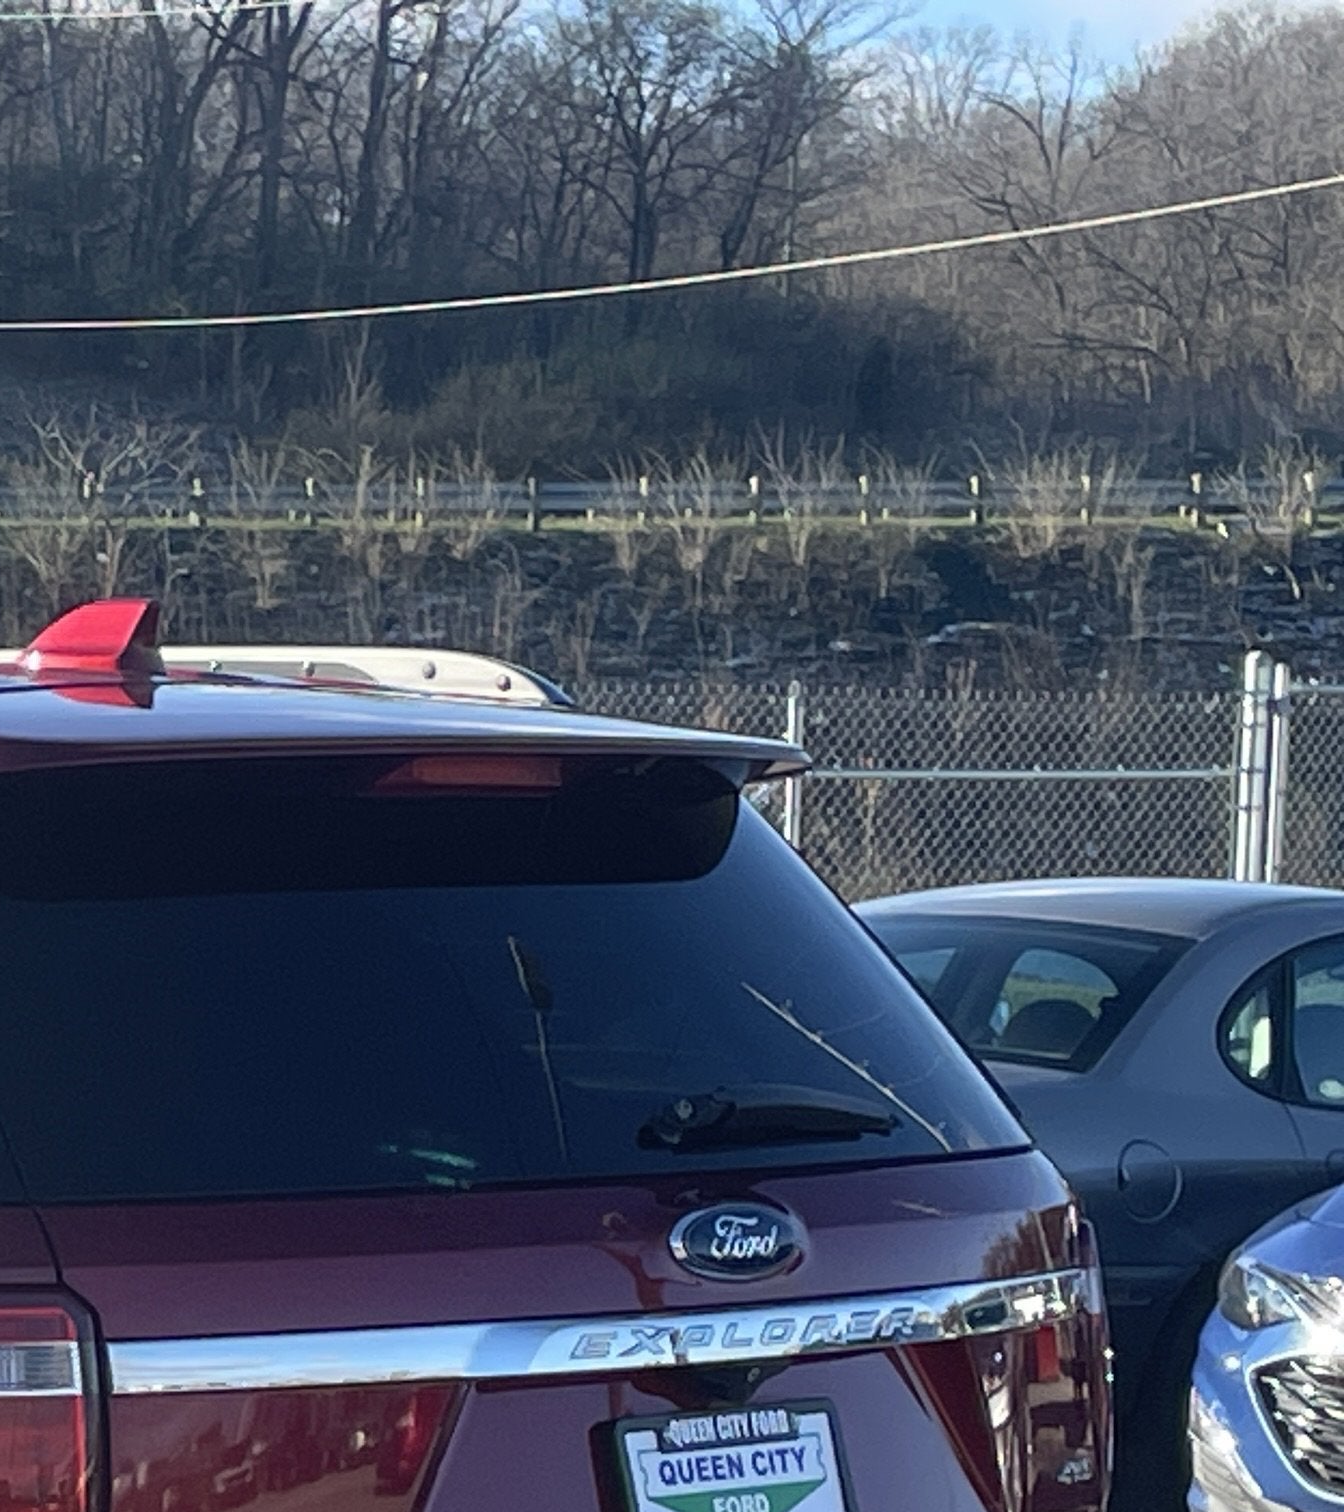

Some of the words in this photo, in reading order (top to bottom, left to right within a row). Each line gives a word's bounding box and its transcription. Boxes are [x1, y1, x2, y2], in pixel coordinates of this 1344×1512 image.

[711, 1214, 778, 1259] Ford
[570, 1306, 914, 1359] EXPLORER
[669, 1416, 716, 1447] QUEEN
[717, 1412, 749, 1439] CITY
[751, 1409, 790, 1437] FORD
[659, 1453, 744, 1486] QUEEN
[752, 1447, 806, 1476] CITY
